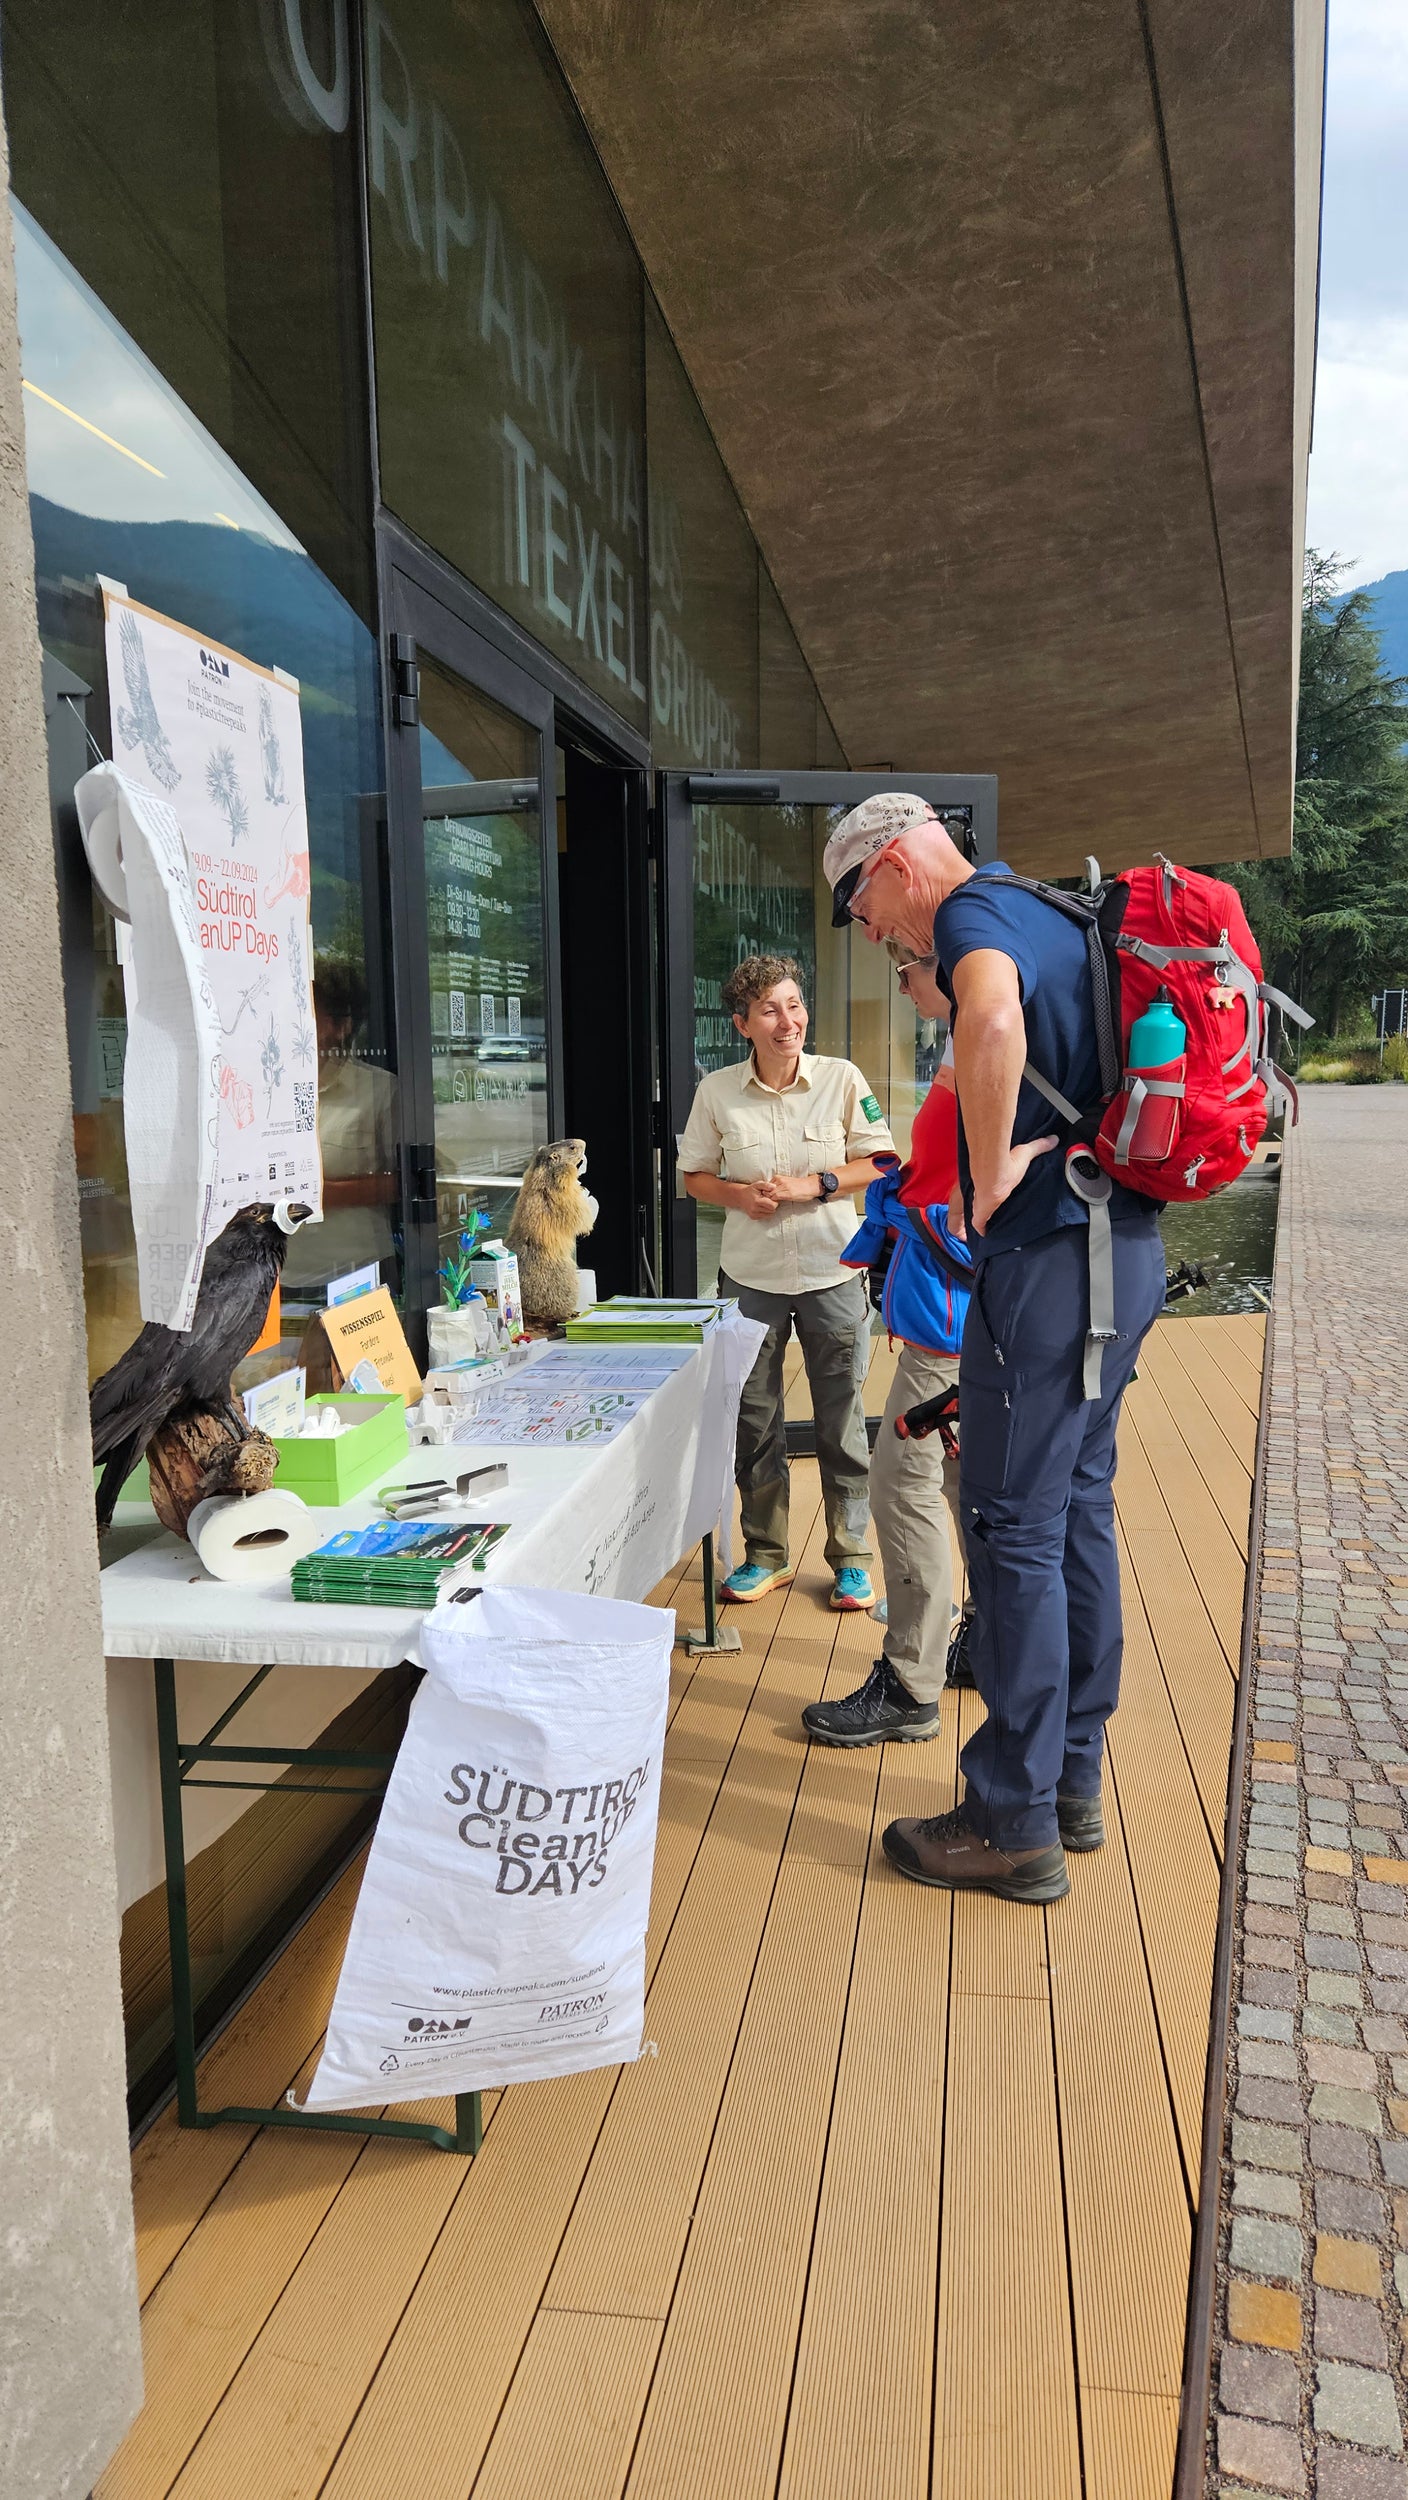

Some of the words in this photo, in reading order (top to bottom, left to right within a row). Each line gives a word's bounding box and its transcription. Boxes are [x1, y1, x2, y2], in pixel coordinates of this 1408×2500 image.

[201, 668, 222, 686] PATRON
[187, 679, 201, 697] Join
[201, 687, 212, 702] the
[213, 694, 244, 716] movement
[187, 698, 195, 711] to
[196, 702, 247, 733] #plasticfreepeaks
[444, 814, 493, 849] ÖFFNUNGSZEITEN
[448, 852, 474, 872] OPENING
[474, 860, 493, 879] HOURS
[451, 837, 469, 855] ORARI
[476, 846, 502, 868] APERTURA
[197, 878, 257, 920] Südtirol
[245, 923, 279, 964] Days
[340, 1309, 385, 1336] WISSENSSPIEL
[443, 1757, 650, 1824] SÜDTIROL
[458, 1797, 636, 1861] CleanUP
[495, 1848, 608, 1896] DAYS
[539, 1991, 608, 2019] PATRON
[403, 2034, 448, 2043] PATRON
[404, 2061, 425, 2069] Every
